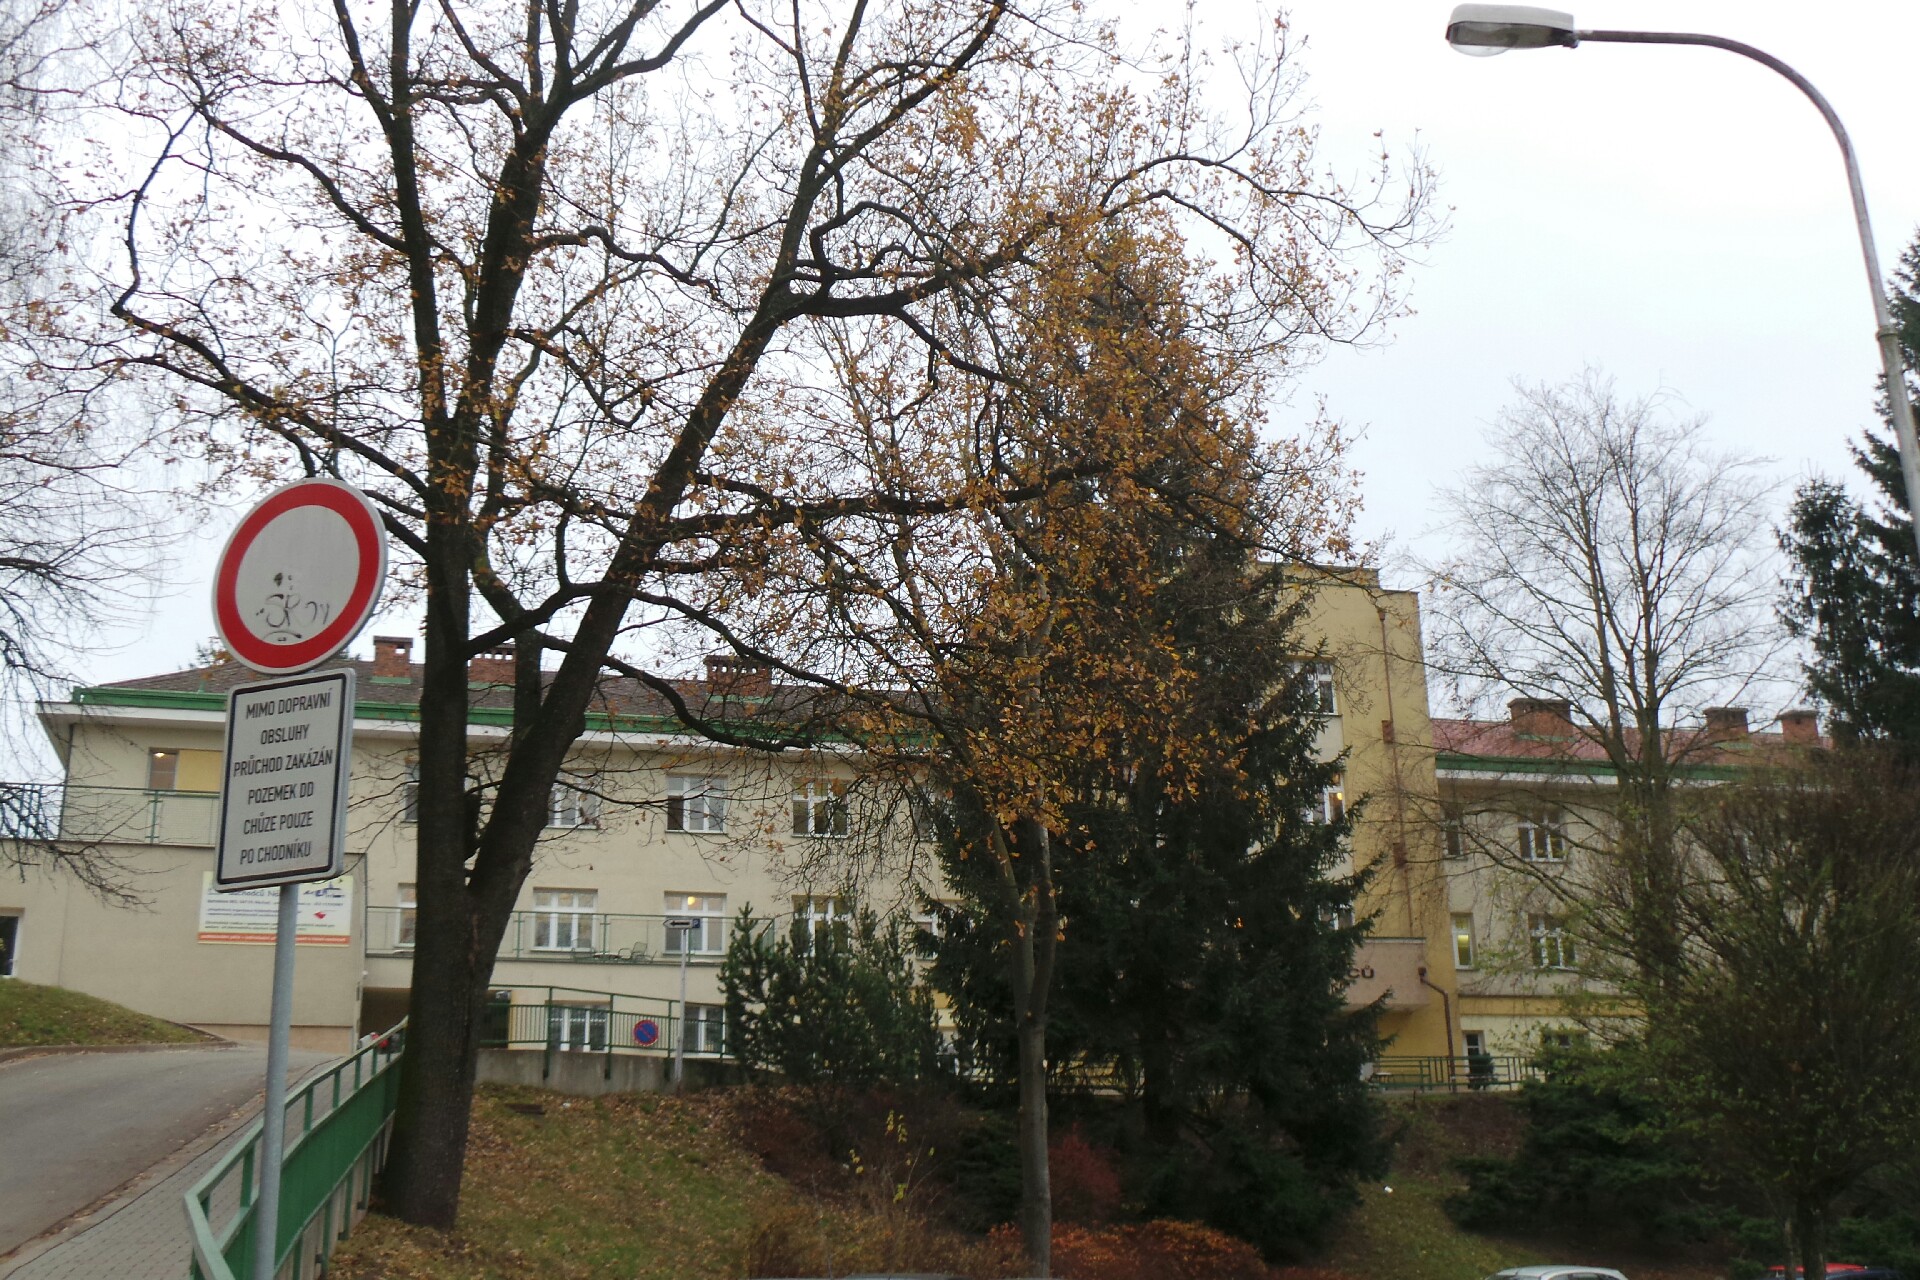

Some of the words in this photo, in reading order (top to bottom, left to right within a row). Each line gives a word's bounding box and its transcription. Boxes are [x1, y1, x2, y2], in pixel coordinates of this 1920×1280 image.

[246, 701, 275, 719] MIMO
[278, 687, 333, 715] DOPRAVNÍ
[260, 723, 310, 745] OBSLUHY
[233, 754, 283, 777] PRŮCHOD
[285, 745, 333, 771] ZAKÁZÁN
[247, 783, 298, 805] POZEMEK
[299, 781, 315, 799] DD
[243, 811, 277, 835] CHŮZE
[280, 810, 314, 831] POUZE
[240, 848, 255, 865] PO
[257, 838, 311, 863] CHODNÍKU
